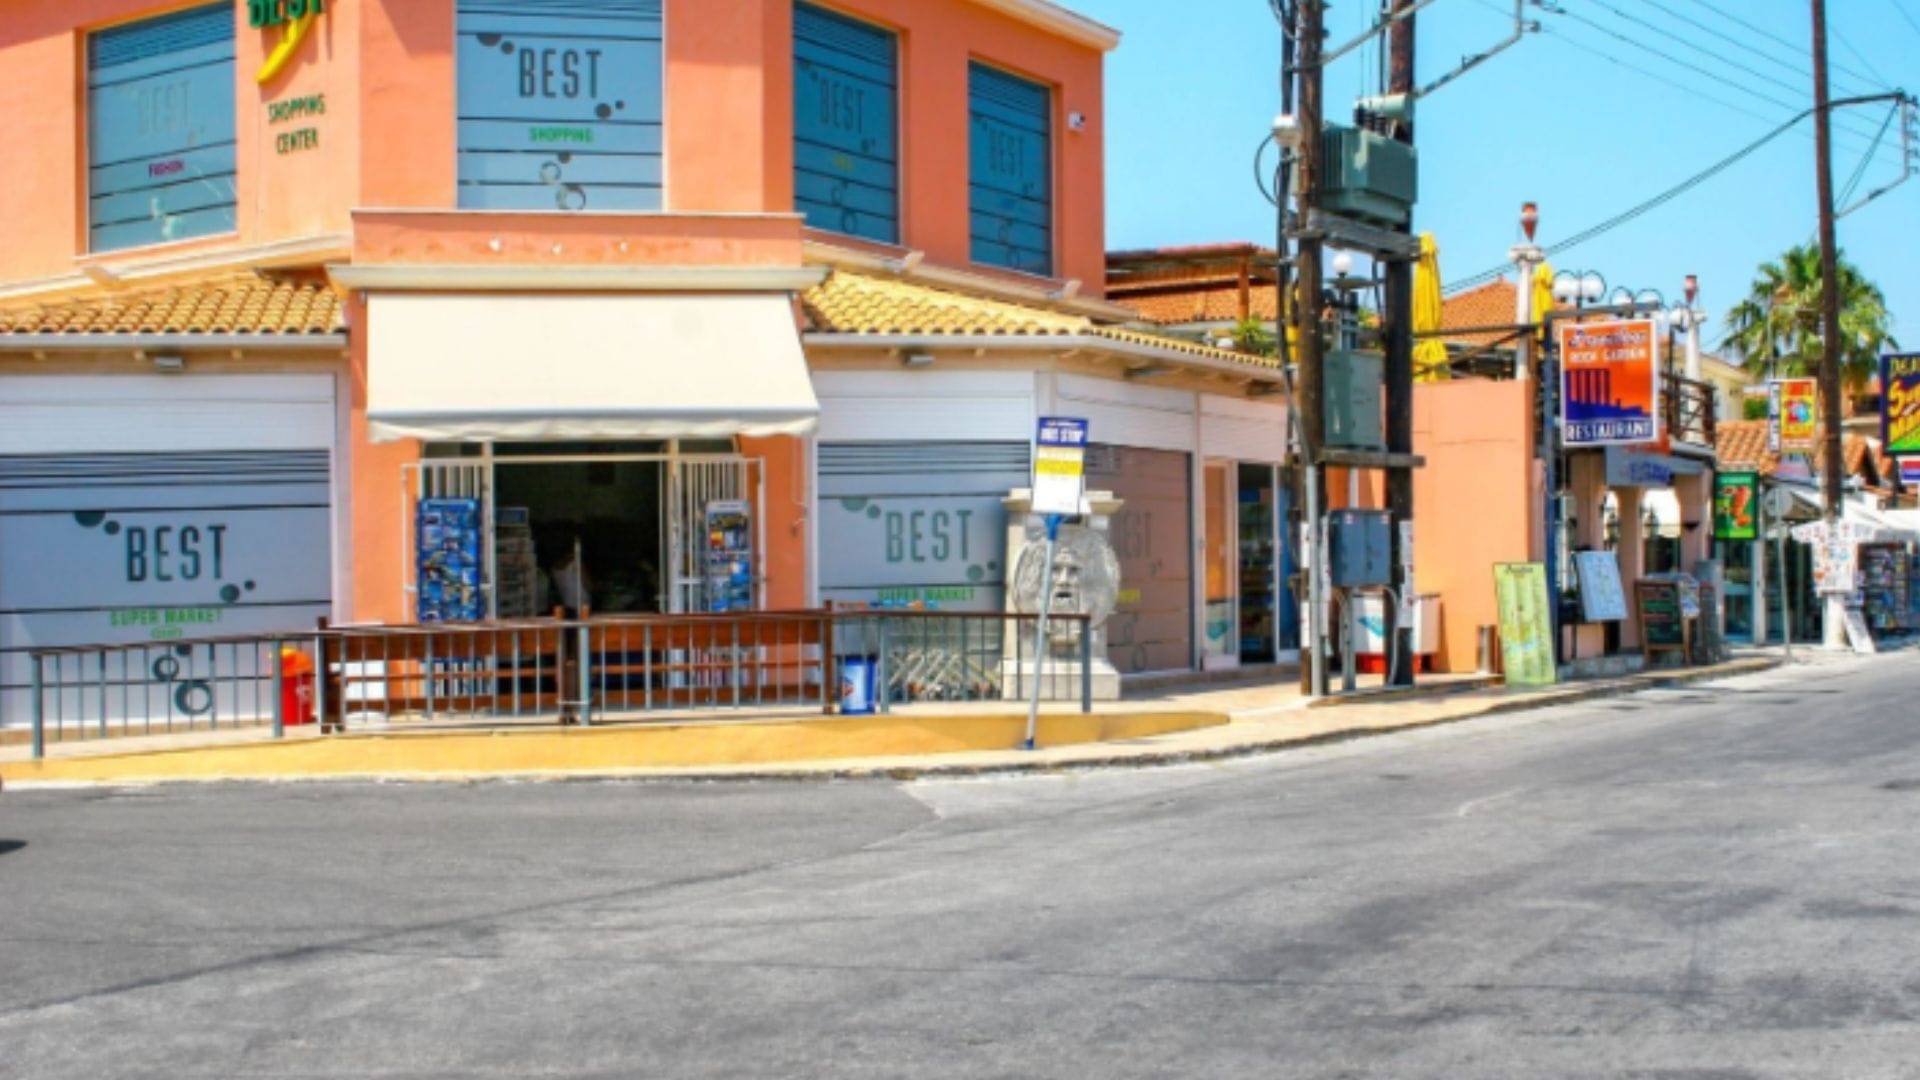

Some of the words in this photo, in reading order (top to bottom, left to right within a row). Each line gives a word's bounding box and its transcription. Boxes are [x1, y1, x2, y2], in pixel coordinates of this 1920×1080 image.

[247, 0, 322, 28] BE
[518, 47, 602, 98] BEST
[138, 81, 190, 136] BEST
[268, 94, 325, 124] SHOPPING
[820, 79, 865, 134] BEST
[276, 128, 318, 155] CENTER
[529, 127, 593, 143] SHOPPING
[989, 128, 1025, 177] BEST
[1060, 429, 1083, 443] STOP
[1564, 420, 1653, 441] RESTAURANT
[885, 509, 973, 562] BEST
[125, 523, 227, 581] BEST
[924, 585, 976, 601] MARKET
[109, 607, 159, 627] SUPER
[164, 605, 224, 624] MARKET
